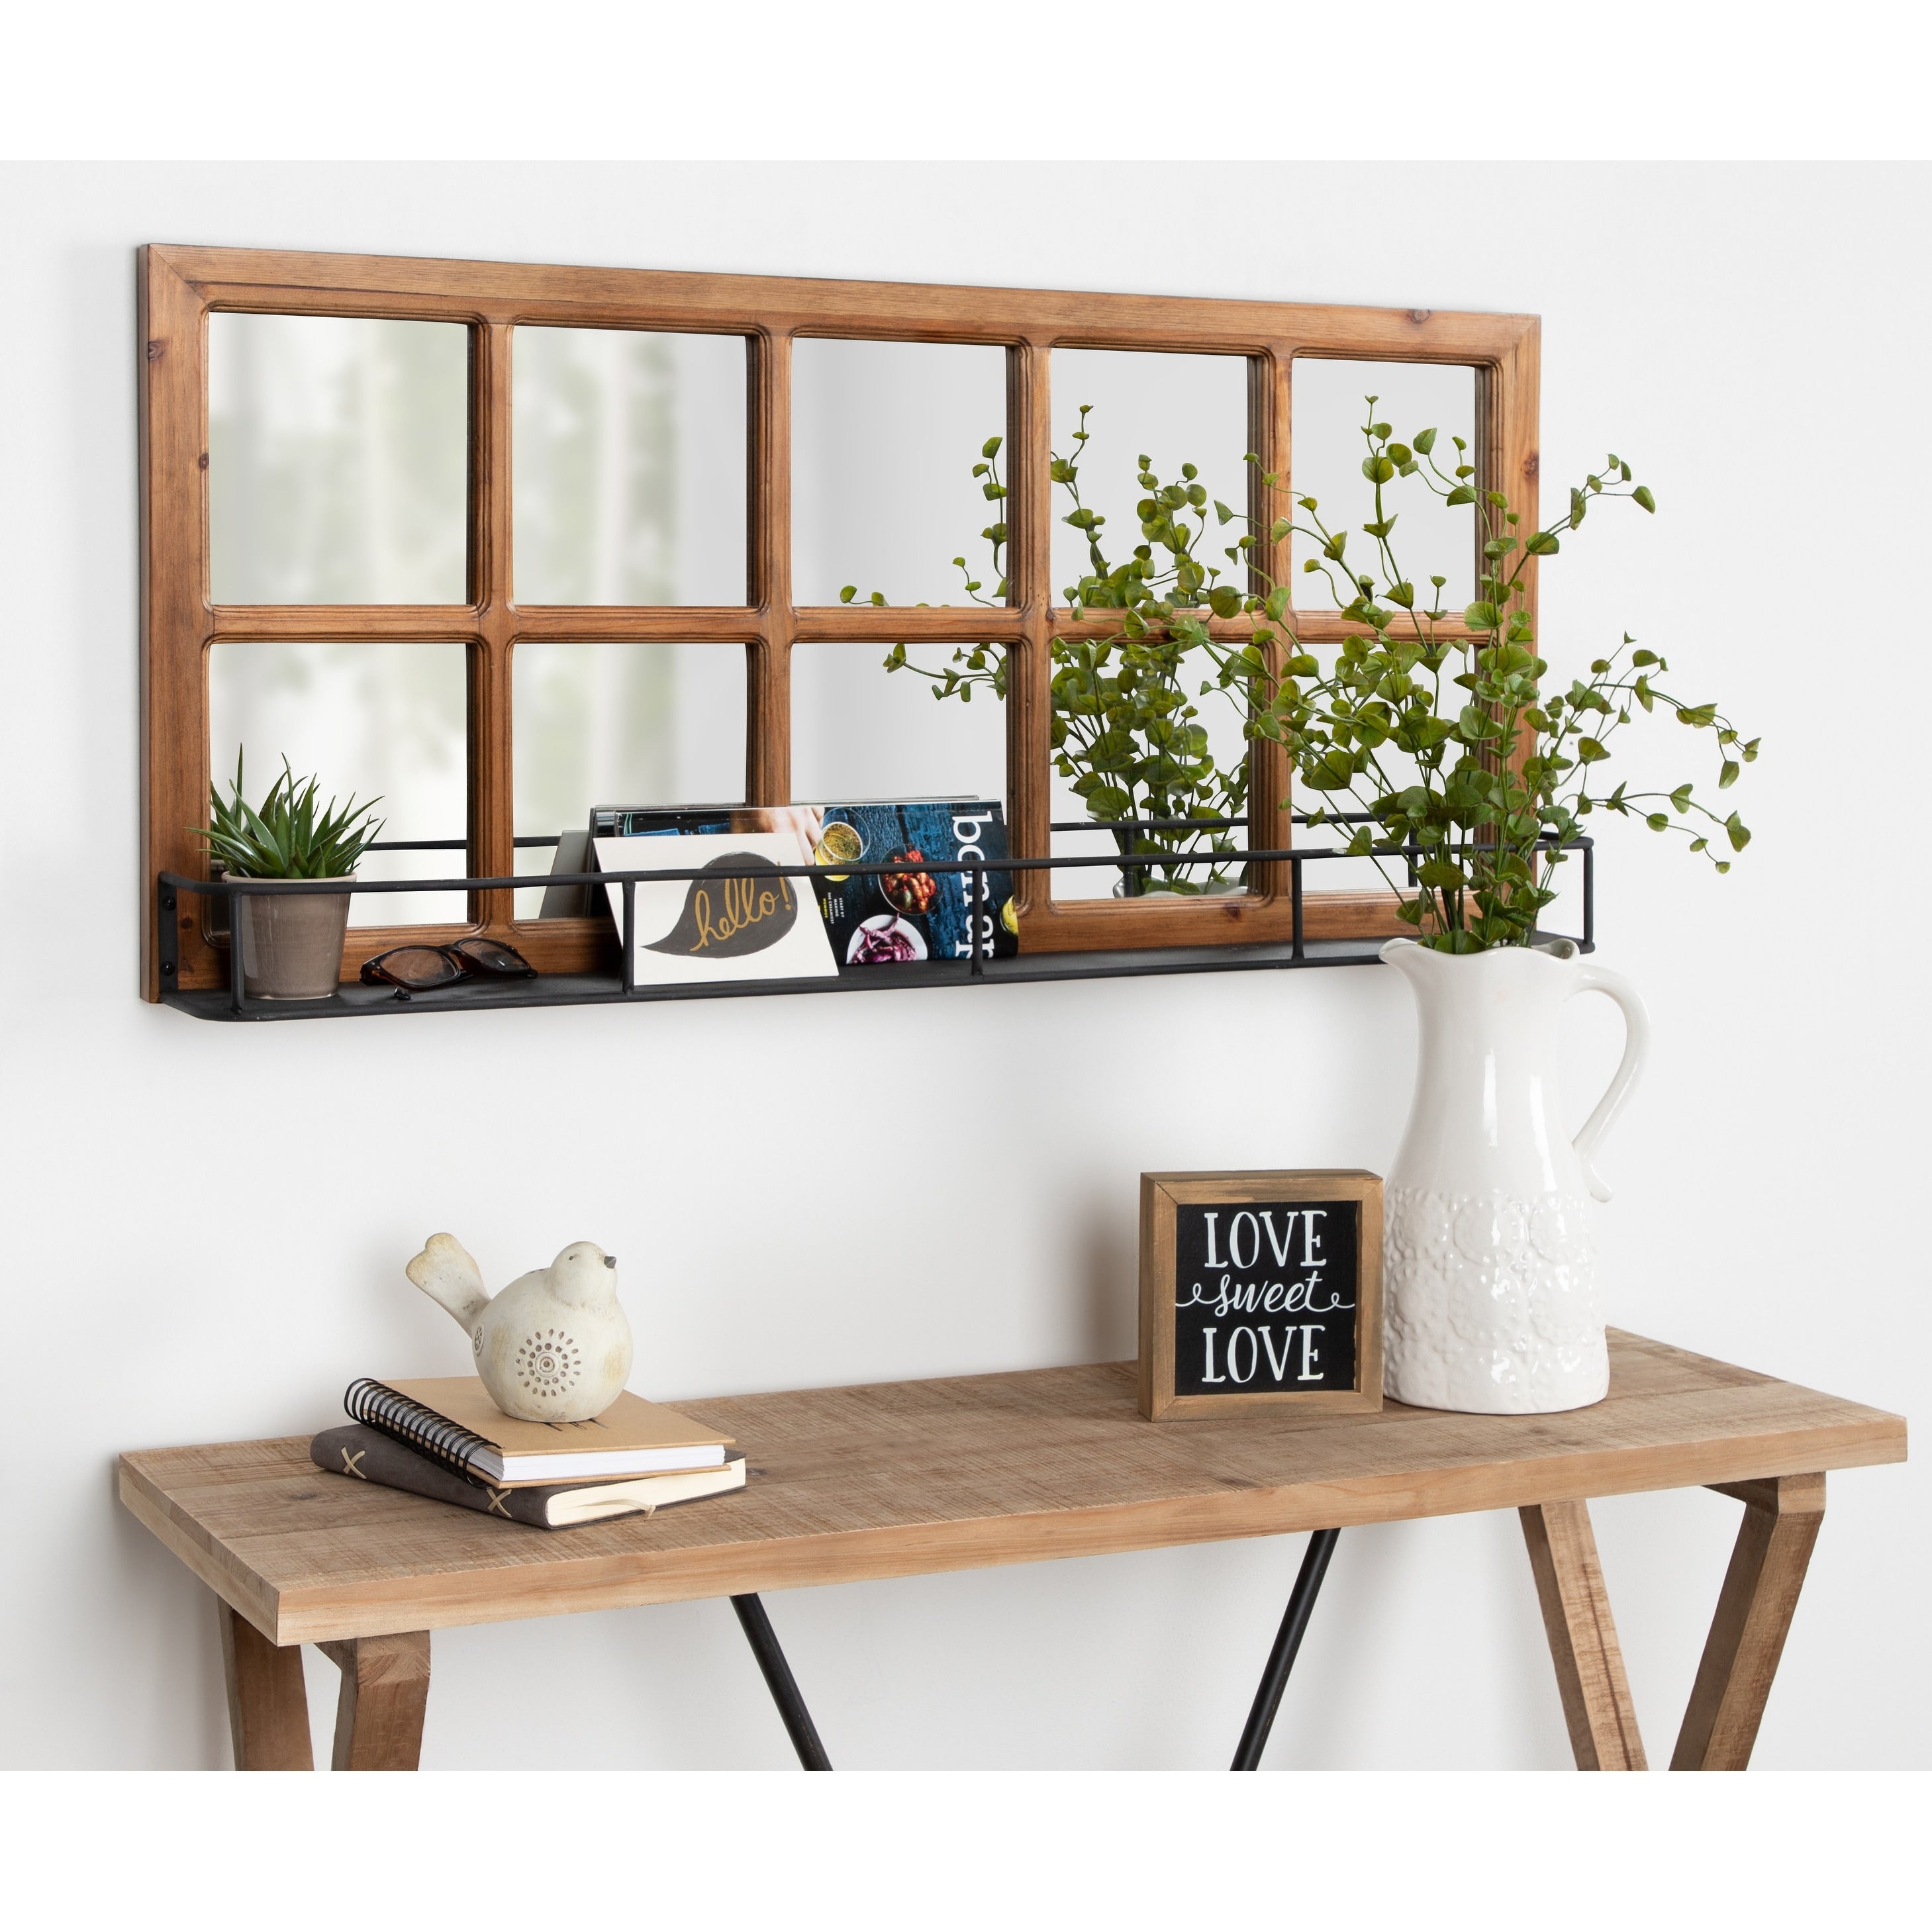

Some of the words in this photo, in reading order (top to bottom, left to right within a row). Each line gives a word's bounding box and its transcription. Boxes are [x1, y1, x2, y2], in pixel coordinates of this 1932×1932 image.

[690, 861, 791, 951] hello!
[1204, 1210, 1328, 1269] LOVE
[1175, 1271, 1355, 1317] sweet
[1202, 1325, 1326, 1383] LOVE
